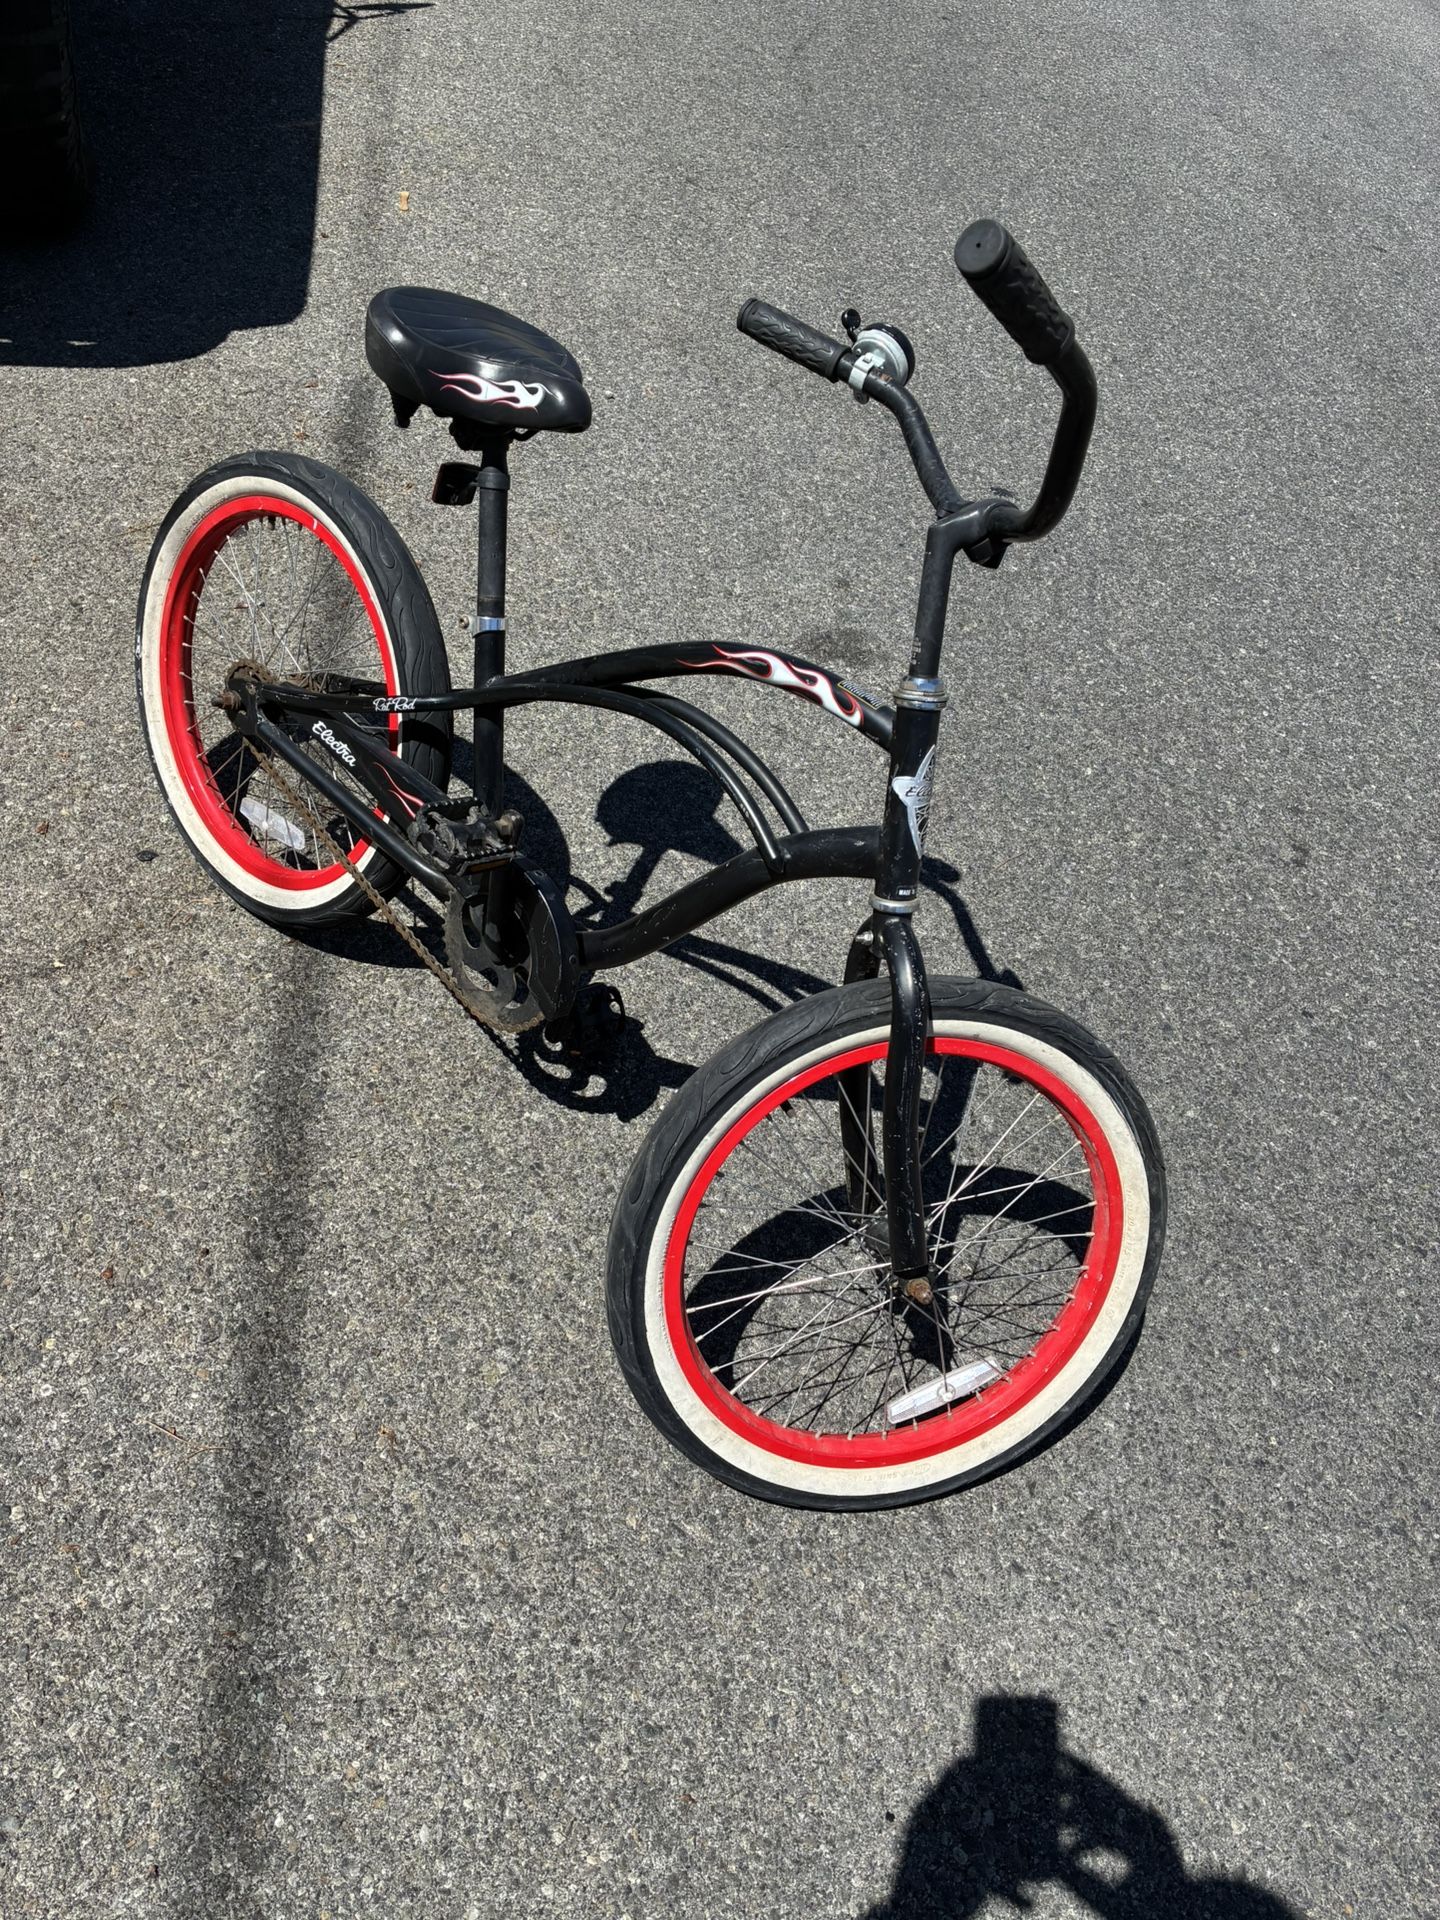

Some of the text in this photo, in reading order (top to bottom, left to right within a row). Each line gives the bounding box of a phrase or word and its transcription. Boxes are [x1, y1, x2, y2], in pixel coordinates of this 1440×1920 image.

[373, 697, 416, 711] Rat Rod
[312, 720, 356, 767] Electra
